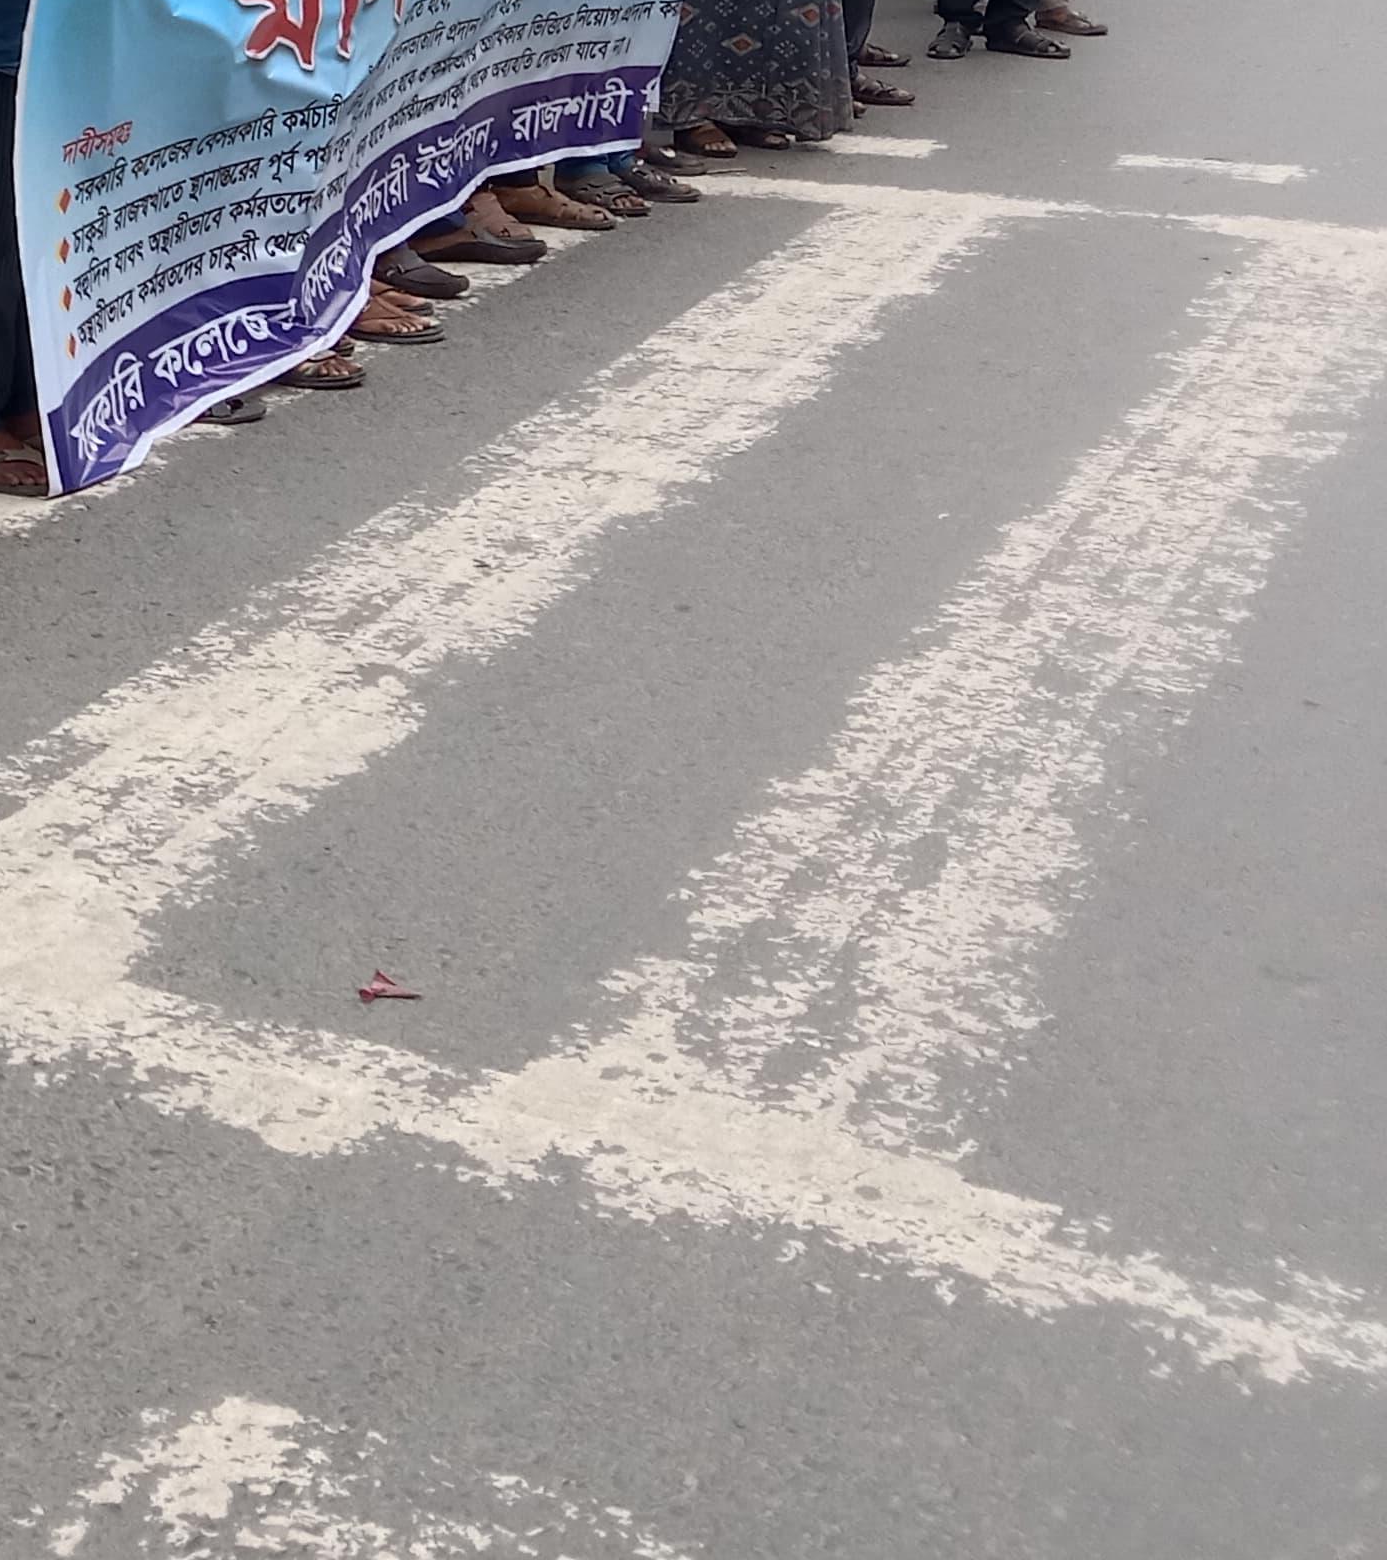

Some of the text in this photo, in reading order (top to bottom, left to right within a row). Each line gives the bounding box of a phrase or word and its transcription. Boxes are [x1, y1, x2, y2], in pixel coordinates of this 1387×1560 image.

[195, 107, 277, 156] বেসরকারি
[512, 77, 633, 144] রাজশাহী
[71, 205, 112, 255] চাকুরী
[208, 228, 260, 273] চাকুরী
